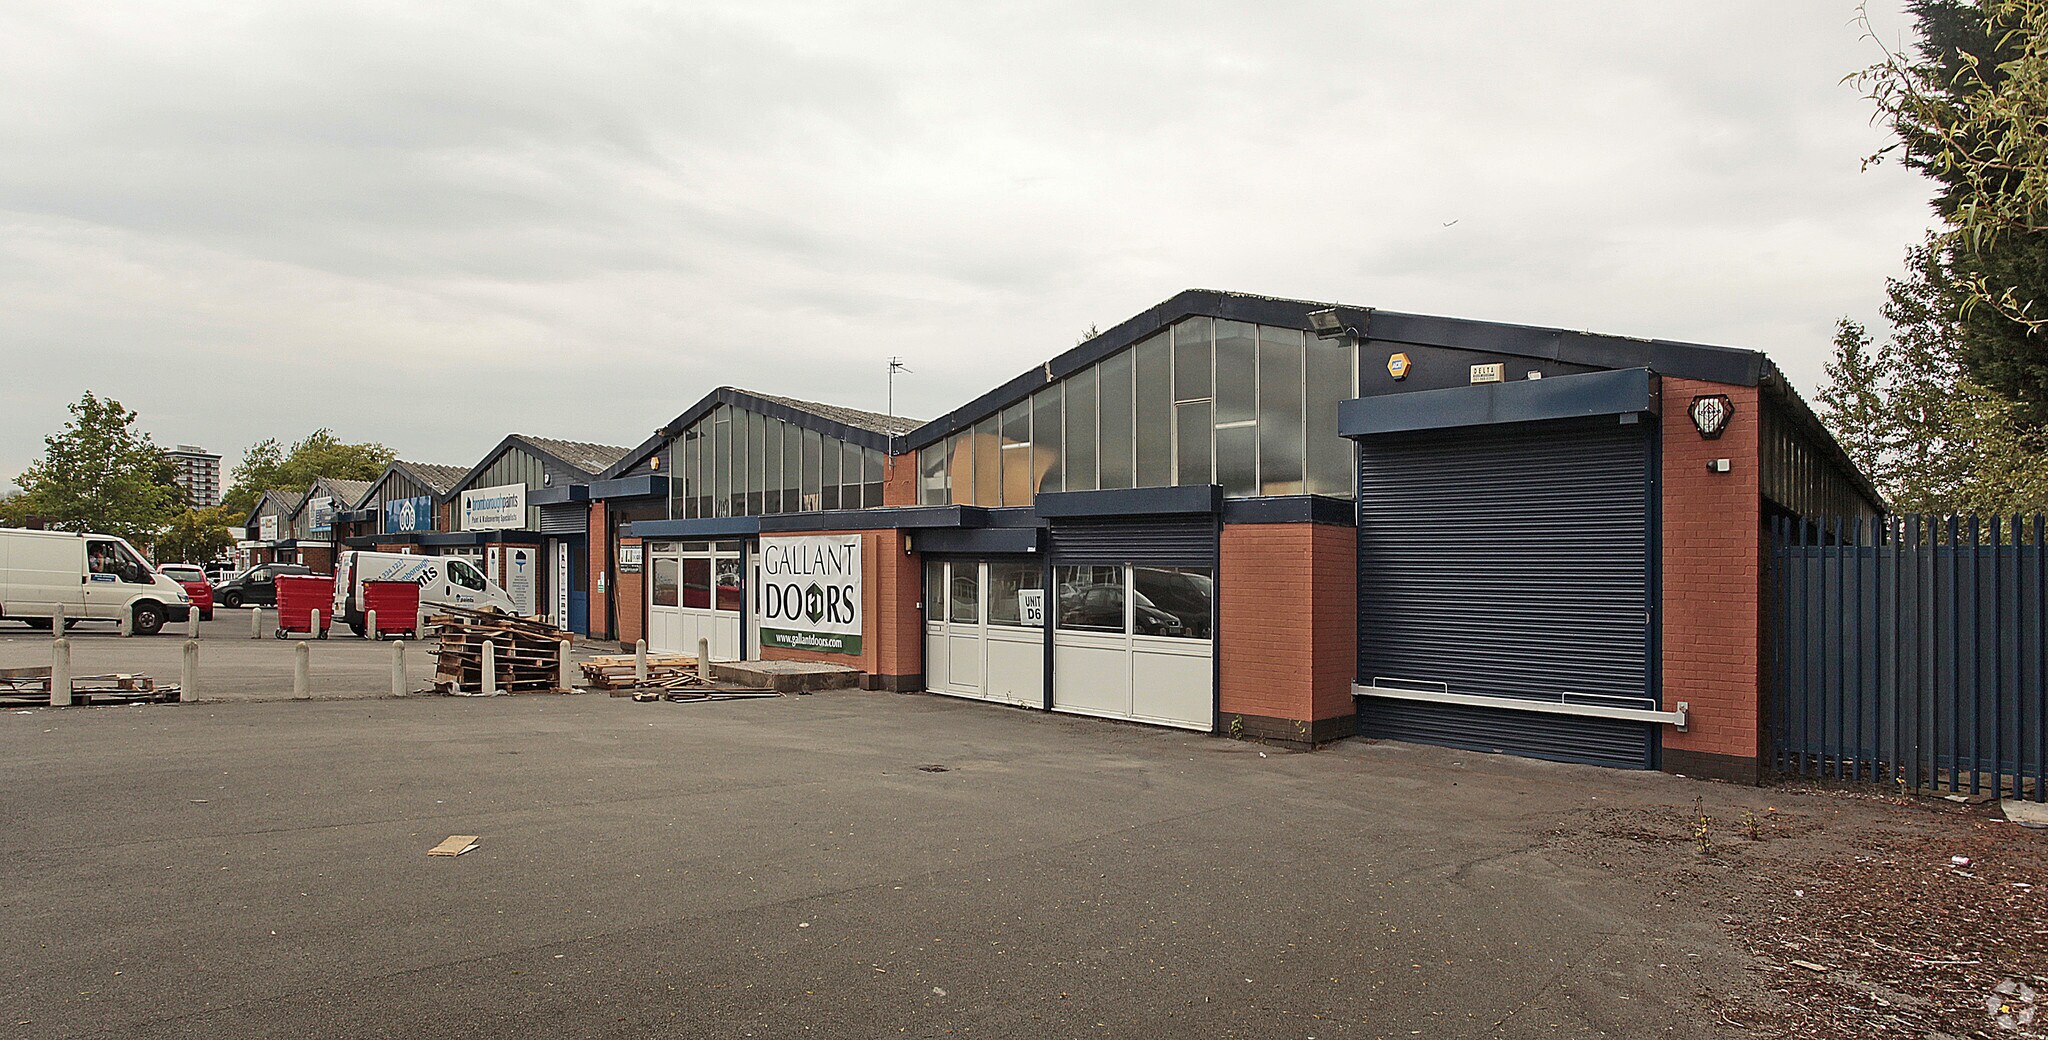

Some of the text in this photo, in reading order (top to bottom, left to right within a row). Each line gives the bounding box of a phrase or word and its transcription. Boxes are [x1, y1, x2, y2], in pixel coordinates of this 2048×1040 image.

[765, 543, 856, 575] GALLANT
[402, 558, 431, 580] mborough
[1025, 595, 1041, 607] UNIT
[1027, 608, 1041, 620] D6
[776, 633, 843, 648] www.gallantdoors.com
